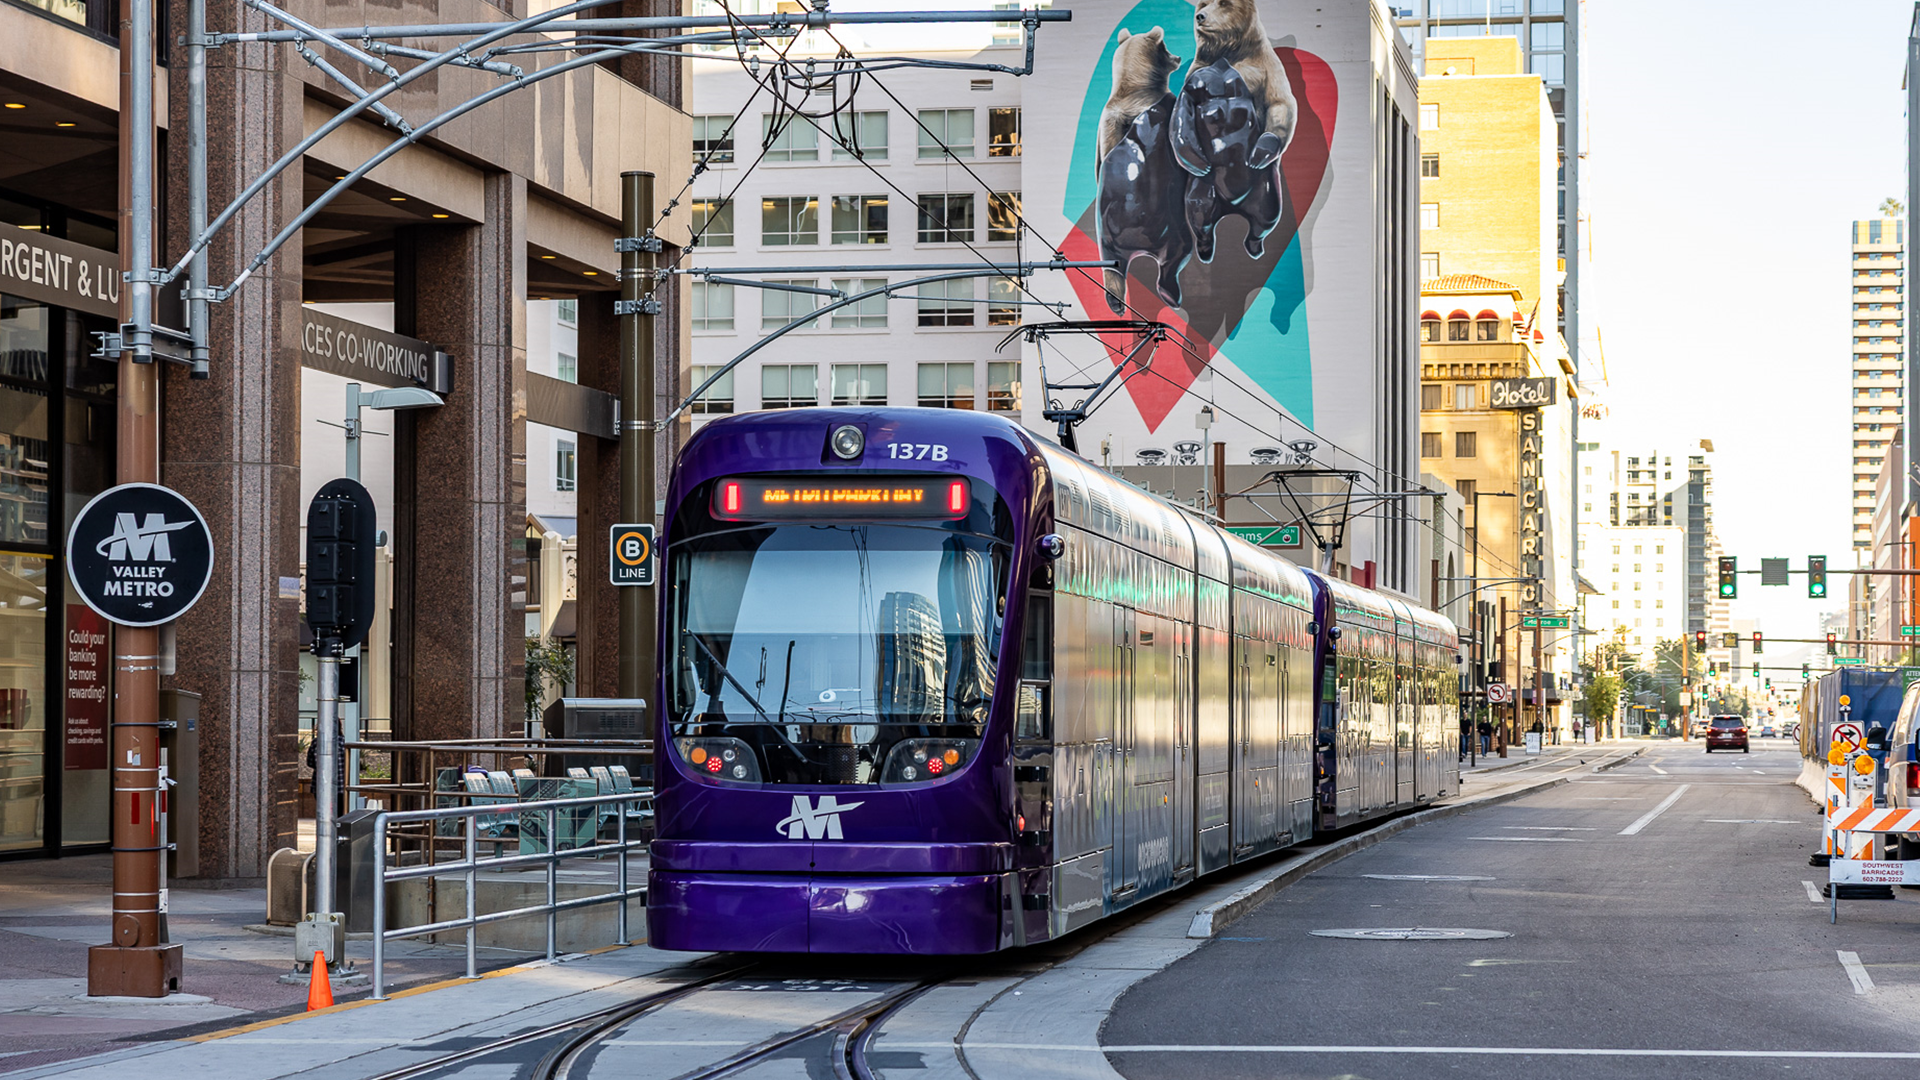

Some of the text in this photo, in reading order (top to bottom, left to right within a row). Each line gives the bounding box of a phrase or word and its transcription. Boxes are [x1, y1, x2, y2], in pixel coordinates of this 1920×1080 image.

[1, 238, 73, 291] RGENT
[77, 259, 92, 298] &
[336, 330, 428, 383] CO-WORKING
[1491, 381, 1550, 406] Hotel
[887, 442, 949, 462] 137B
[1522, 412, 1536, 614] SAN CARLO
[625, 540, 640, 557] B
[112, 566, 166, 578] VALLEY
[619, 568, 646, 578] LINE
[103, 581, 174, 597] METRO
[69, 629, 105, 648] Could your
[69, 648, 97, 666] banking
[68, 666, 96, 681] be more
[68, 685, 106, 703] rewarding?
[83, 727, 94, 736] savings
